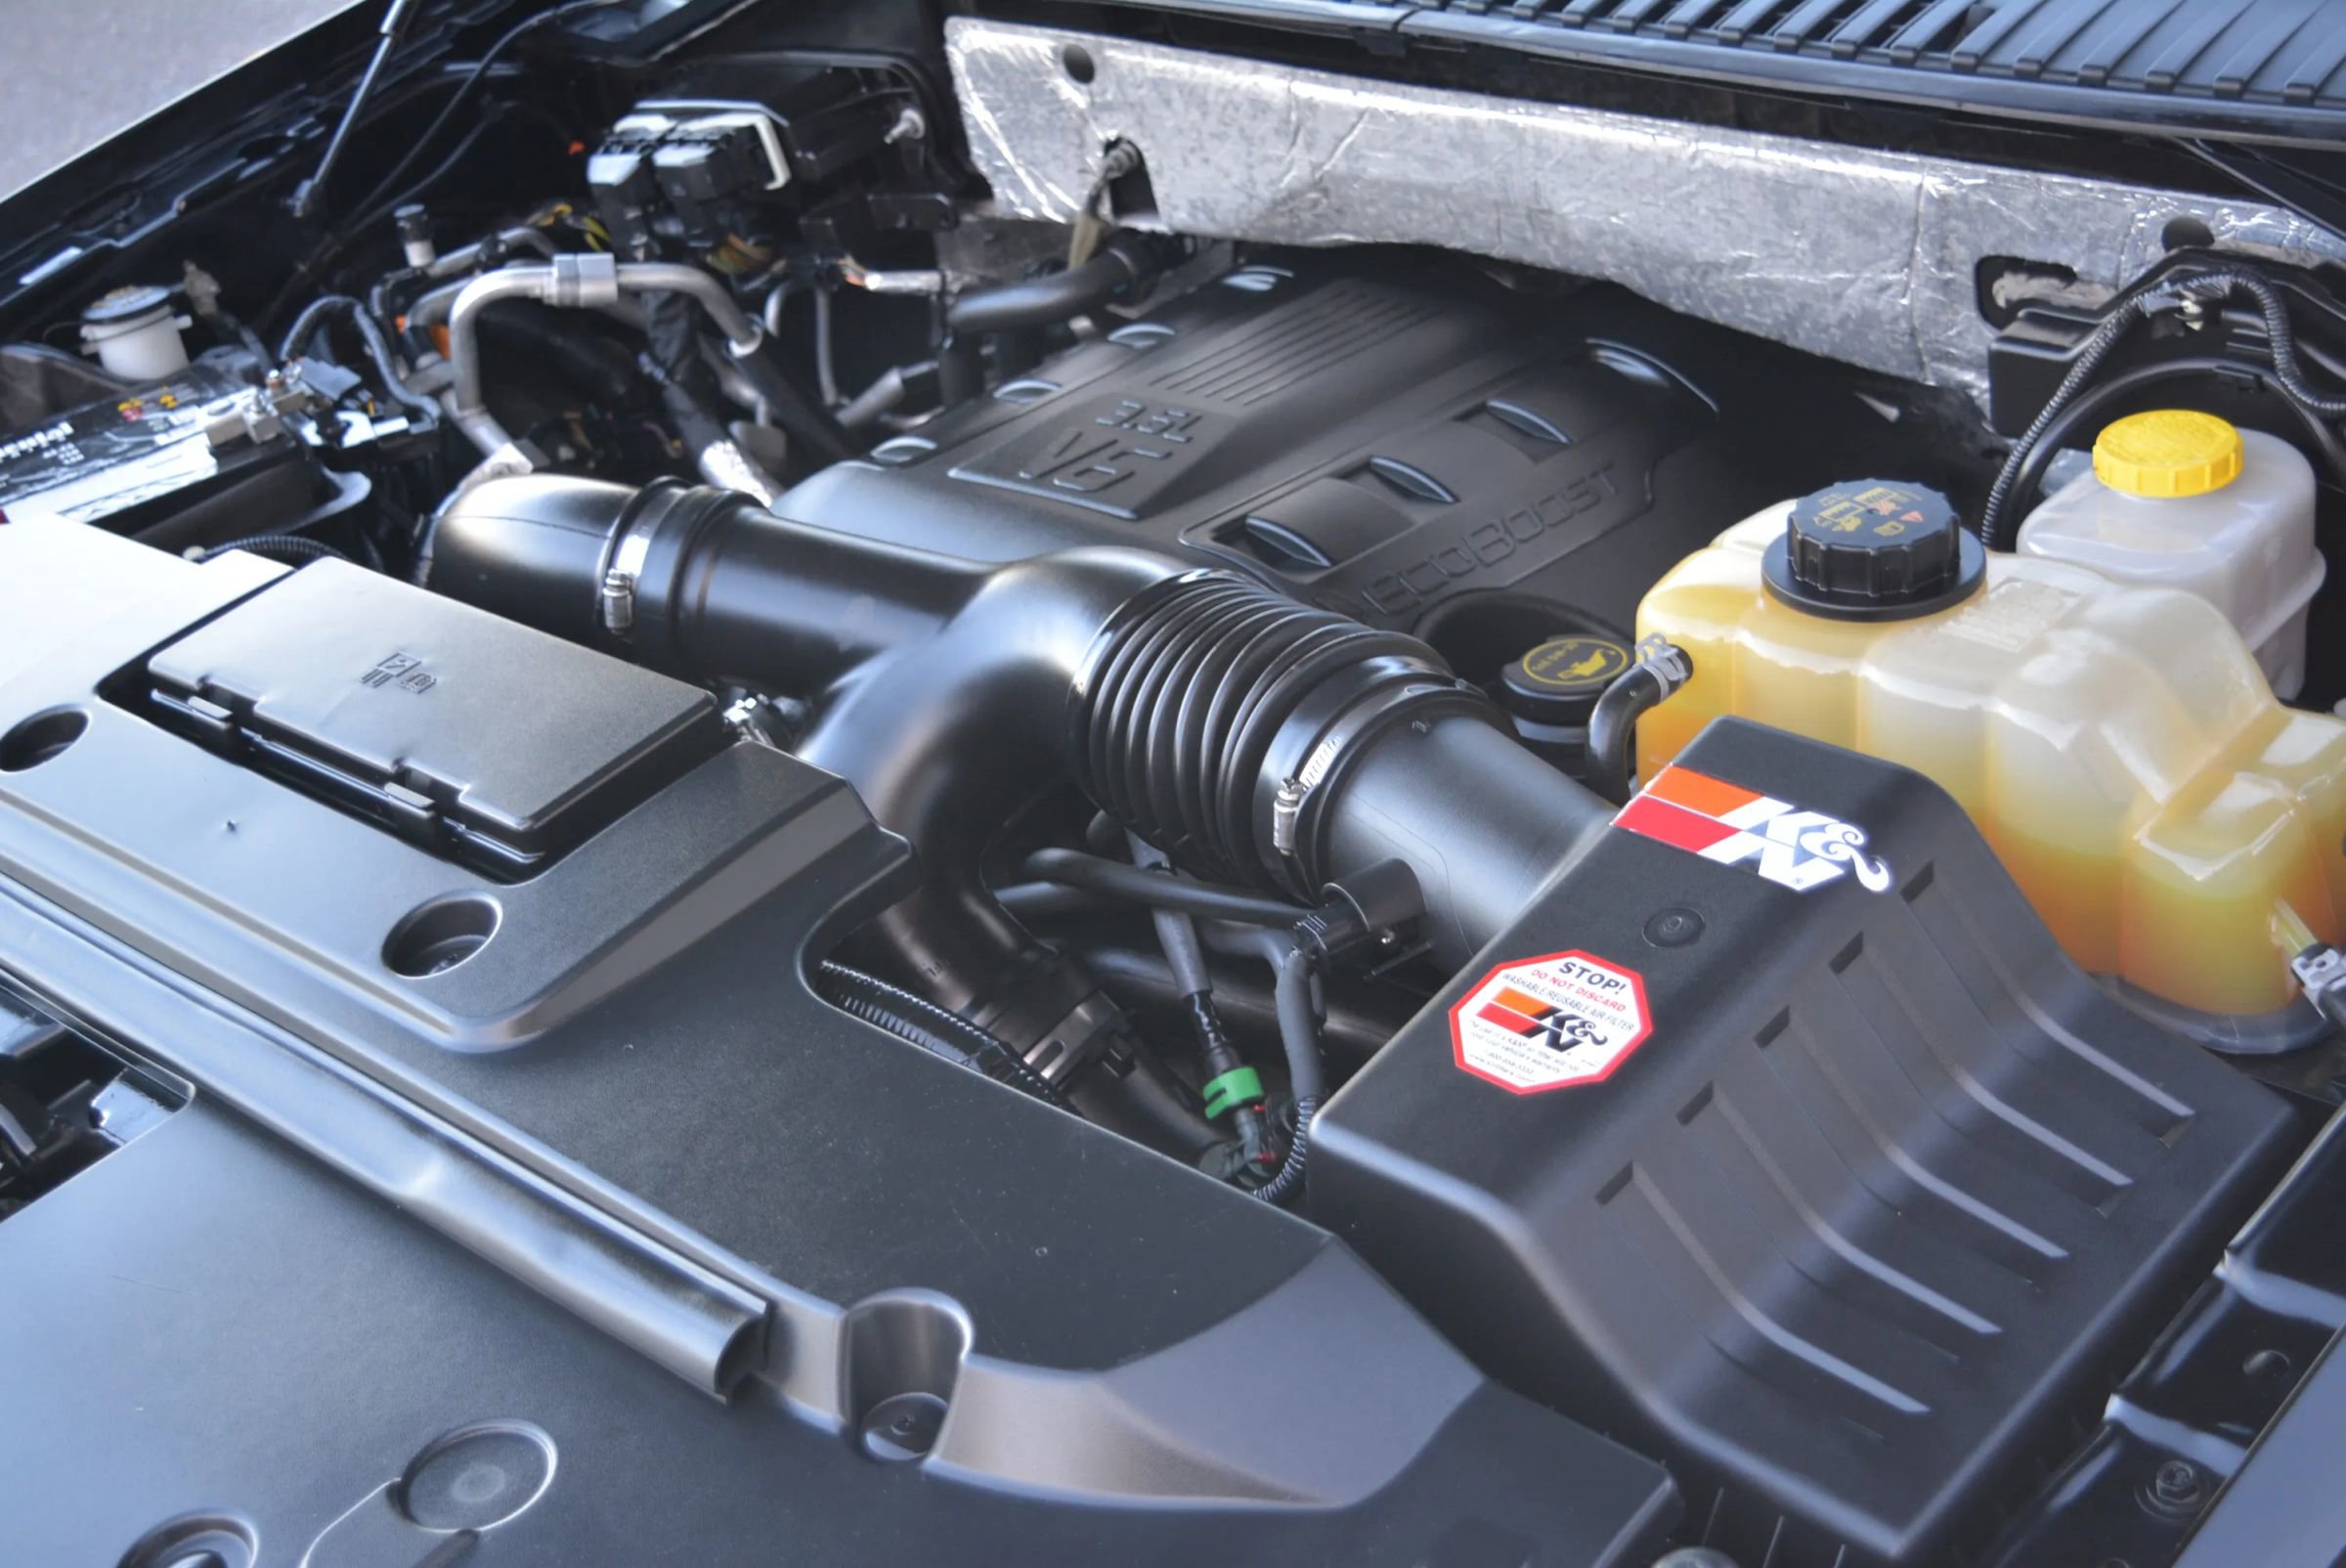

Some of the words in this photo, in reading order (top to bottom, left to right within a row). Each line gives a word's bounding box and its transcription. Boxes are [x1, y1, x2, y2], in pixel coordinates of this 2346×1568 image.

[1018, 430, 1173, 493] V6
[1531, 969, 1548, 980] DO
[1549, 976, 1574, 990] NOT
[1575, 984, 1627, 1013] DISCARD
[1558, 961, 1628, 995] STOP!
[1519, 1005, 1608, 1053] K&N
[1588, 1008, 1606, 1020] AIR
[1606, 1014, 1635, 1032] FILTER
